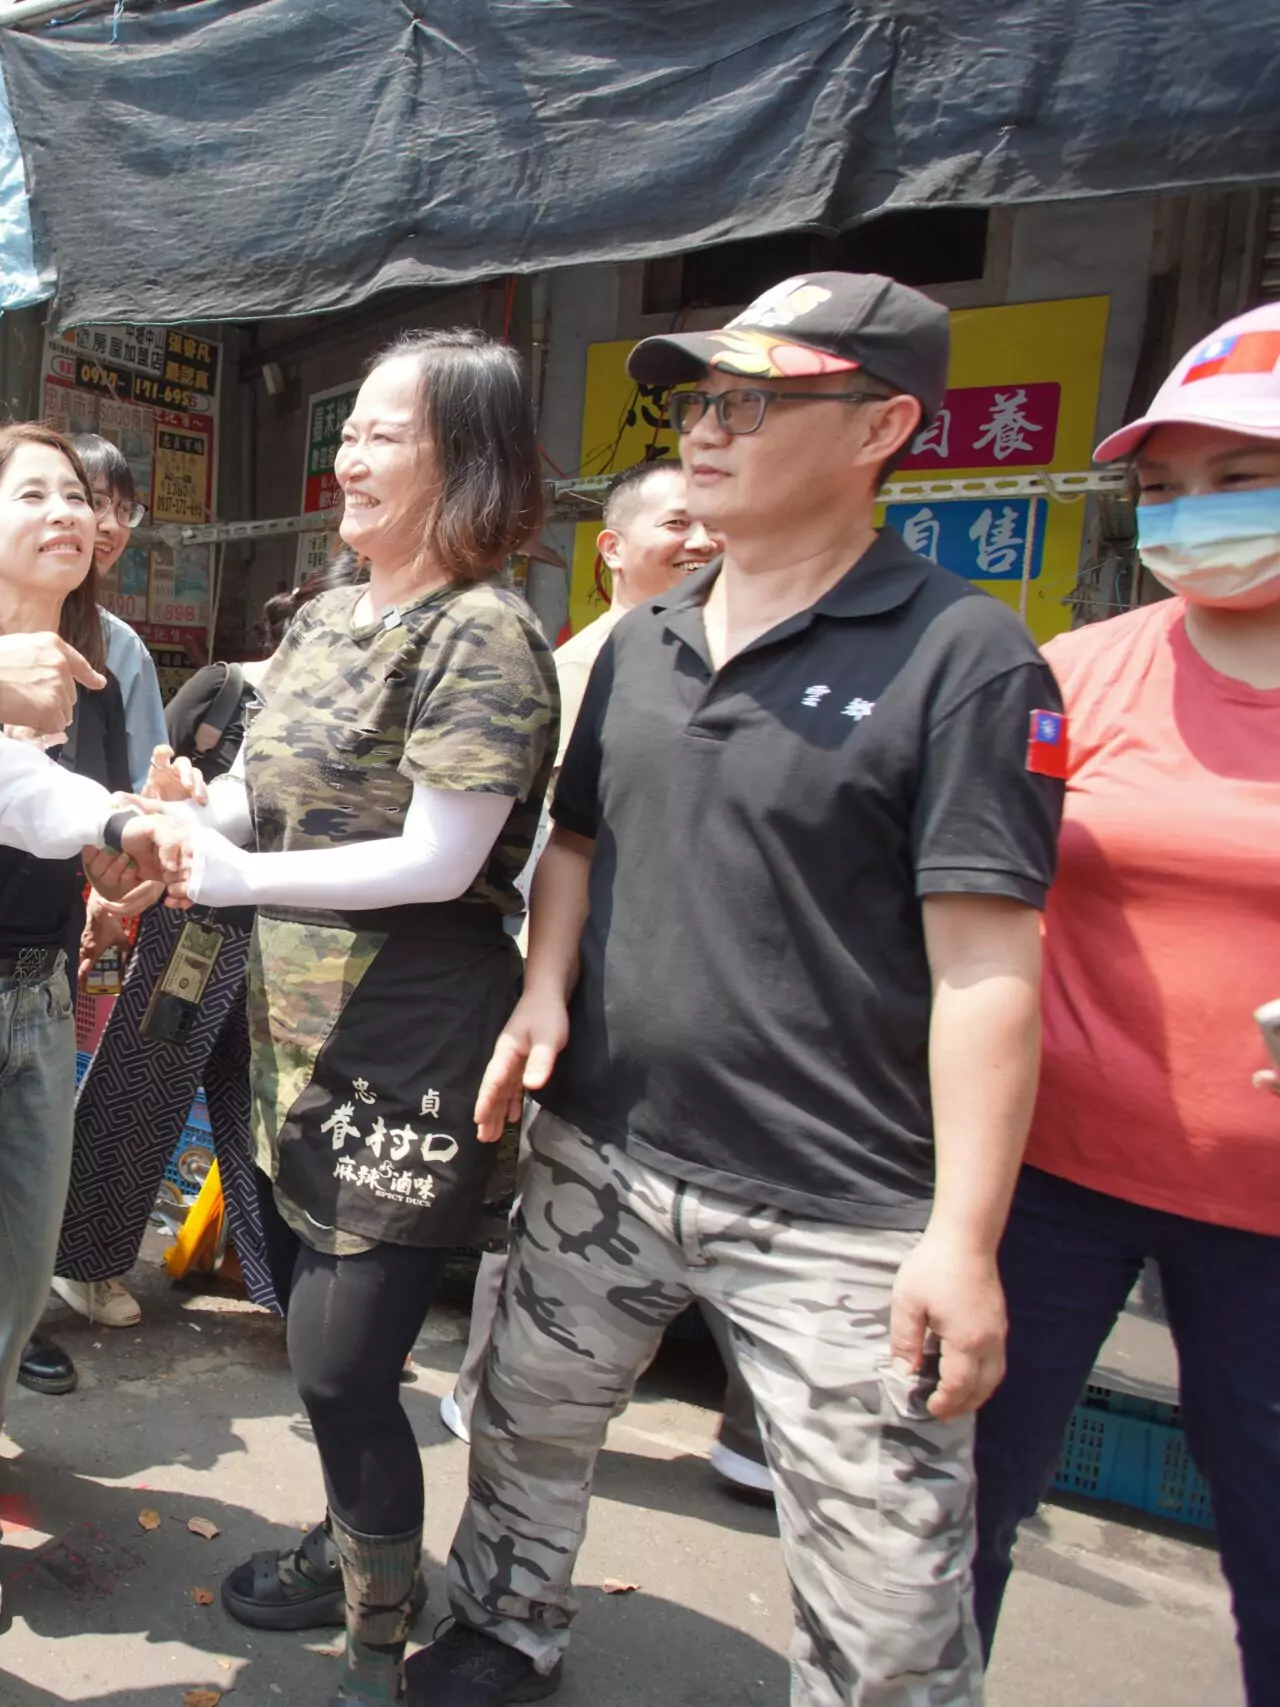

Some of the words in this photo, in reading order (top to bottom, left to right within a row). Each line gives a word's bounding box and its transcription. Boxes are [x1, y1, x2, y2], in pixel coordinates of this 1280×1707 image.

[903, 506, 1024, 574] 自售
[321, 1101, 459, 1163] 眷村口
[333, 1155, 436, 1200] 麻辣滷味
[375, 1190, 405, 1203] SPICY
[405, 1195, 432, 1208] DUCK
